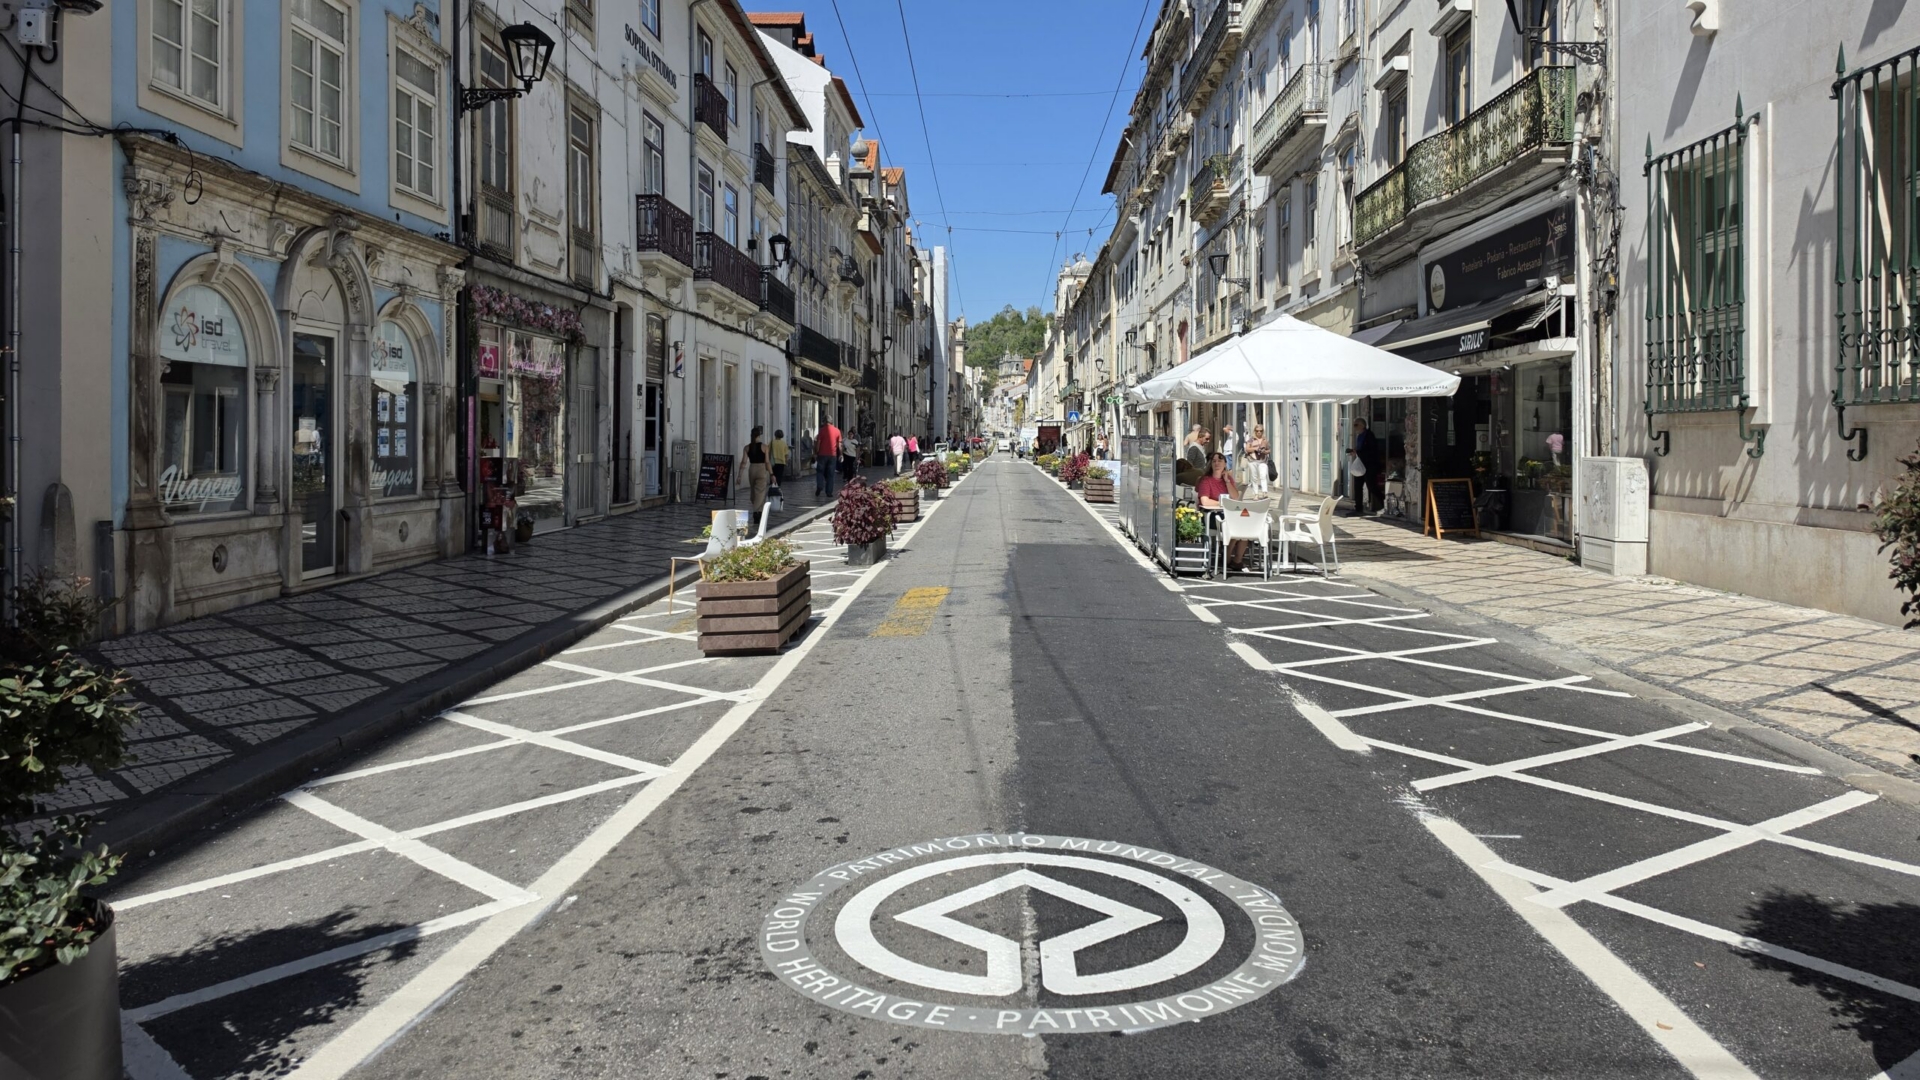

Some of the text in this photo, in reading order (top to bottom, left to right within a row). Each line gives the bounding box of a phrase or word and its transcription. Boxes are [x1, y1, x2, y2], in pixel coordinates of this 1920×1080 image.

[625, 23, 676, 90] SOPHIA STUDIOS
[1461, 256, 1483, 274] Pastelaria
[1508, 236, 1542, 257] Restaurante
[1497, 265, 1517, 281] Fabrico
[1517, 252, 1543, 274] Artesanal
[201, 315, 223, 337] isd
[1459, 331, 1485, 352] SIRIUS
[389, 343, 403, 359] isd
[159, 464, 243, 513] Viagens
[828, 836, 1224, 885] PATRIMÓNIO MUNDIAL
[766, 892, 956, 1026] WORLD HERITAGE
[996, 888, 1297, 1029] PATRIMOINE MONDIAL
